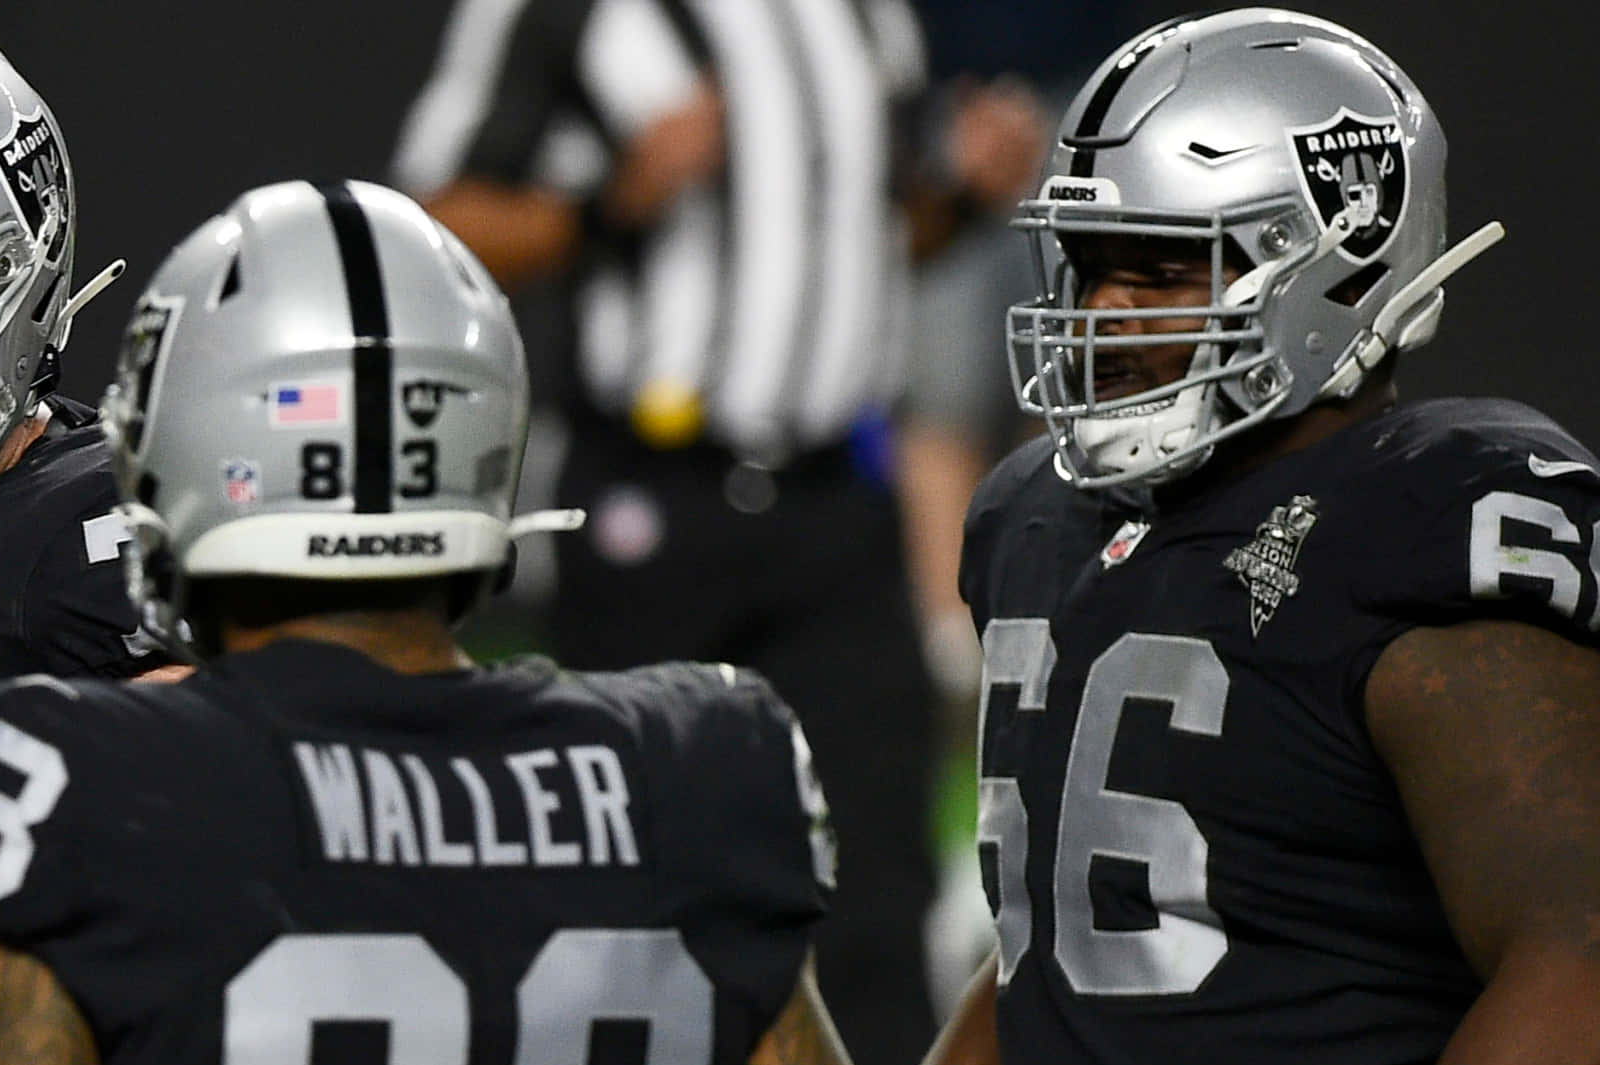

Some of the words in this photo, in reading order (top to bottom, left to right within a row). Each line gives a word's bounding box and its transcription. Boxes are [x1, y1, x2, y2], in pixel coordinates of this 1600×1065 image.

[1306, 126, 1391, 153] RAIDERS
[306, 532, 446, 559] RAIDERS
[293, 740, 639, 867] WALLER
[976, 618, 1230, 994] 66
